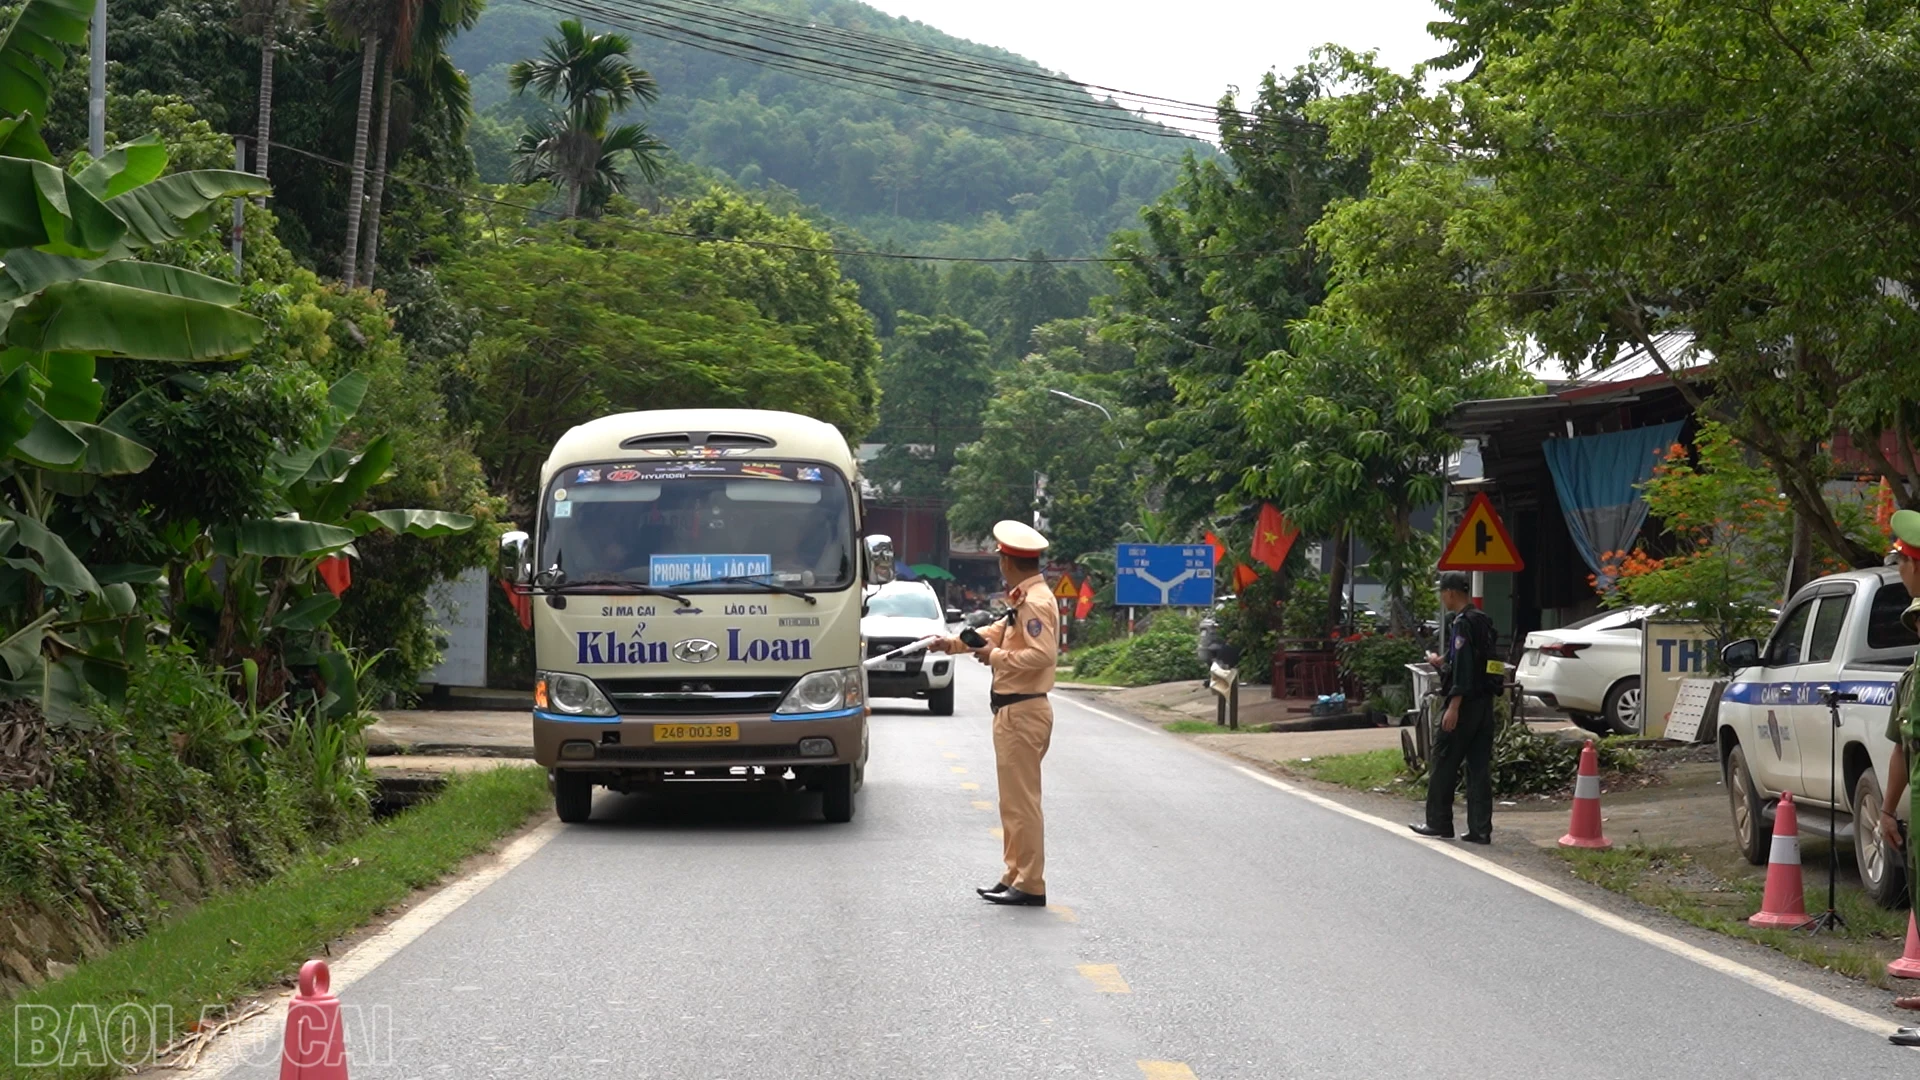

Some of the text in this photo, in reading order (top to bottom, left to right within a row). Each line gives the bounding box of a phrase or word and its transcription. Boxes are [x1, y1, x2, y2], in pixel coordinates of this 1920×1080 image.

[654, 563, 691, 582] PHONG
[693, 556, 712, 581] HẢI
[602, 606, 656, 617] SI MA CAI
[725, 603, 767, 615] LÀO CAI
[576, 622, 812, 664] Khẩn Loan
[1872, 682, 1896, 705] THÔ
